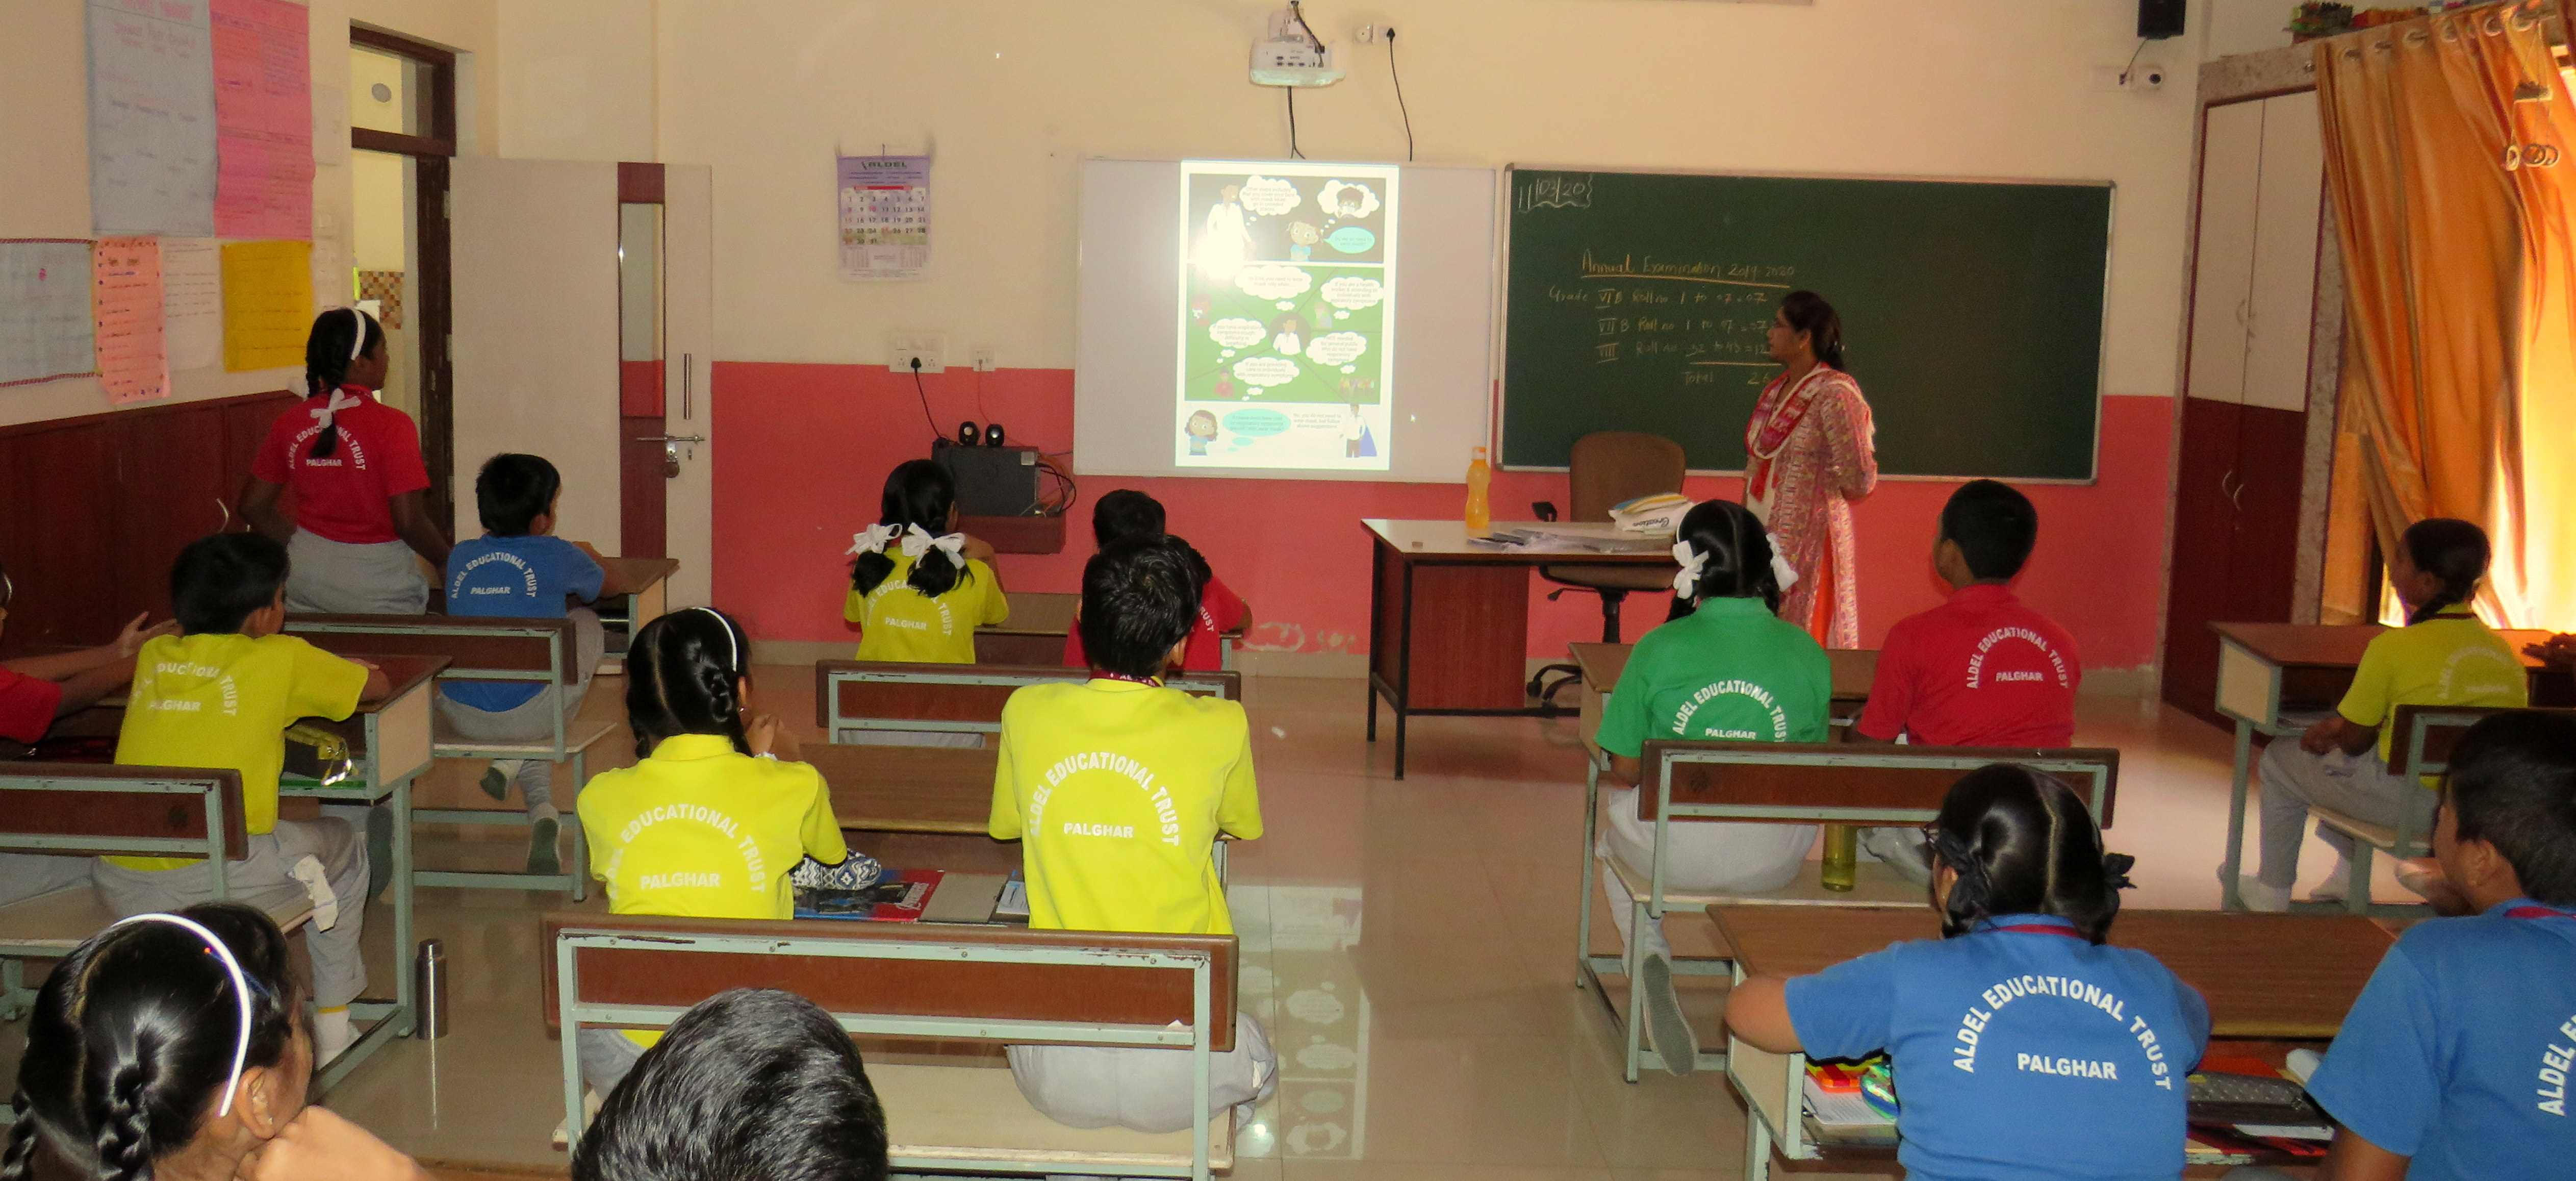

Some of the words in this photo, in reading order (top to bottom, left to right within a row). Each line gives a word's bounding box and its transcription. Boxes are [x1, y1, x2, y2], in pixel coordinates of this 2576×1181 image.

[1582, 249, 1632, 273] Annual
[1549, 286, 1589, 302] Grade
[296, 425, 352, 443] EDUCNAL
[349, 440, 366, 470] TRUST
[306, 459, 343, 467] PALGHAR
[451, 570, 468, 599] ALDEL
[466, 552, 527, 570] EDUCATIONAL
[524, 568, 537, 597] TRUST
[876, 580, 940, 605] EDUCAL
[938, 603, 953, 636] TRUST
[1200, 607, 1214, 633] RUST
[885, 617, 927, 631] PALGHAR
[1967, 654, 1984, 689] ALDEL
[1978, 627, 2048, 653] EDUCATIONAL
[2049, 649, 2069, 688] TRUST
[1996, 671, 2044, 682] PALGHAR
[149, 699, 202, 711] GHAR
[220, 675, 237, 716] TRUST
[1672, 701, 1698, 735] ALDEL
[1694, 680, 1774, 709] EDUCATIONAL
[1705, 728, 1756, 739] PALGHAR
[1029, 785, 1053, 838] ALDEL
[1045, 751, 1154, 791] EDUCATIONAL
[1151, 786, 1180, 846] TRUST
[1063, 822, 1134, 838] PALGHAR
[620, 803, 739, 843] EDUCATIONAL
[738, 835, 767, 893] TRUST
[640, 872, 722, 890] PALGHAR
[1953, 1007, 1992, 1073] ALDEL
[1982, 974, 2124, 1022] EDUCATIONAL
[2129, 1015, 2172, 1090] TRUST
[2017, 1052, 2118, 1081] PALGHAR
[2537, 1043, 2575, 1117] ALDEL
